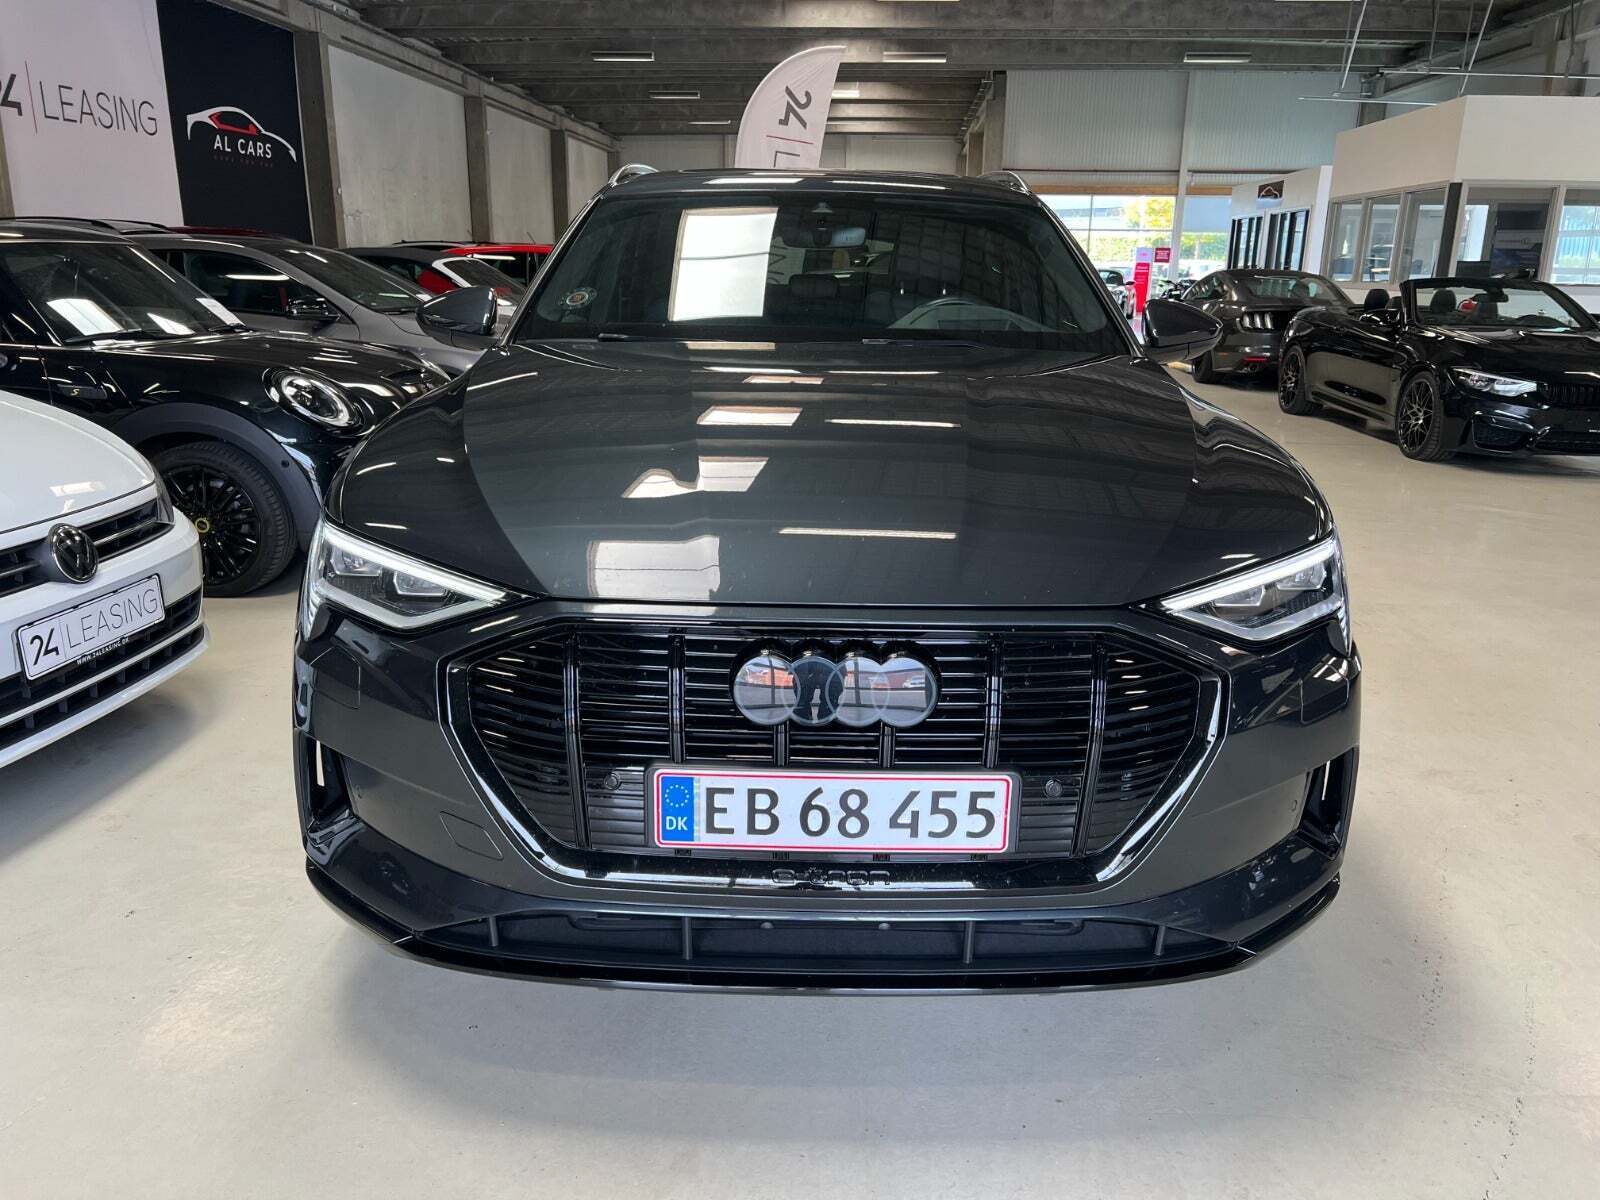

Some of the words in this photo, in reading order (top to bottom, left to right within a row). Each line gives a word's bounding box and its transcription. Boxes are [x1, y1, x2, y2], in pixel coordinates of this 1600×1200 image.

[0, 73, 23, 117] 4
[39, 80, 158, 136] LEASING
[778, 85, 812, 130] 24
[213, 133, 232, 153] AL
[237, 138, 272, 159] CARS
[29, 627, 60, 666] 24
[66, 588, 158, 649] LEASING
[665, 815, 689, 832] DK
[704, 787, 780, 836] EB
[799, 786, 870, 839] 68
[888, 790, 996, 839] 455
